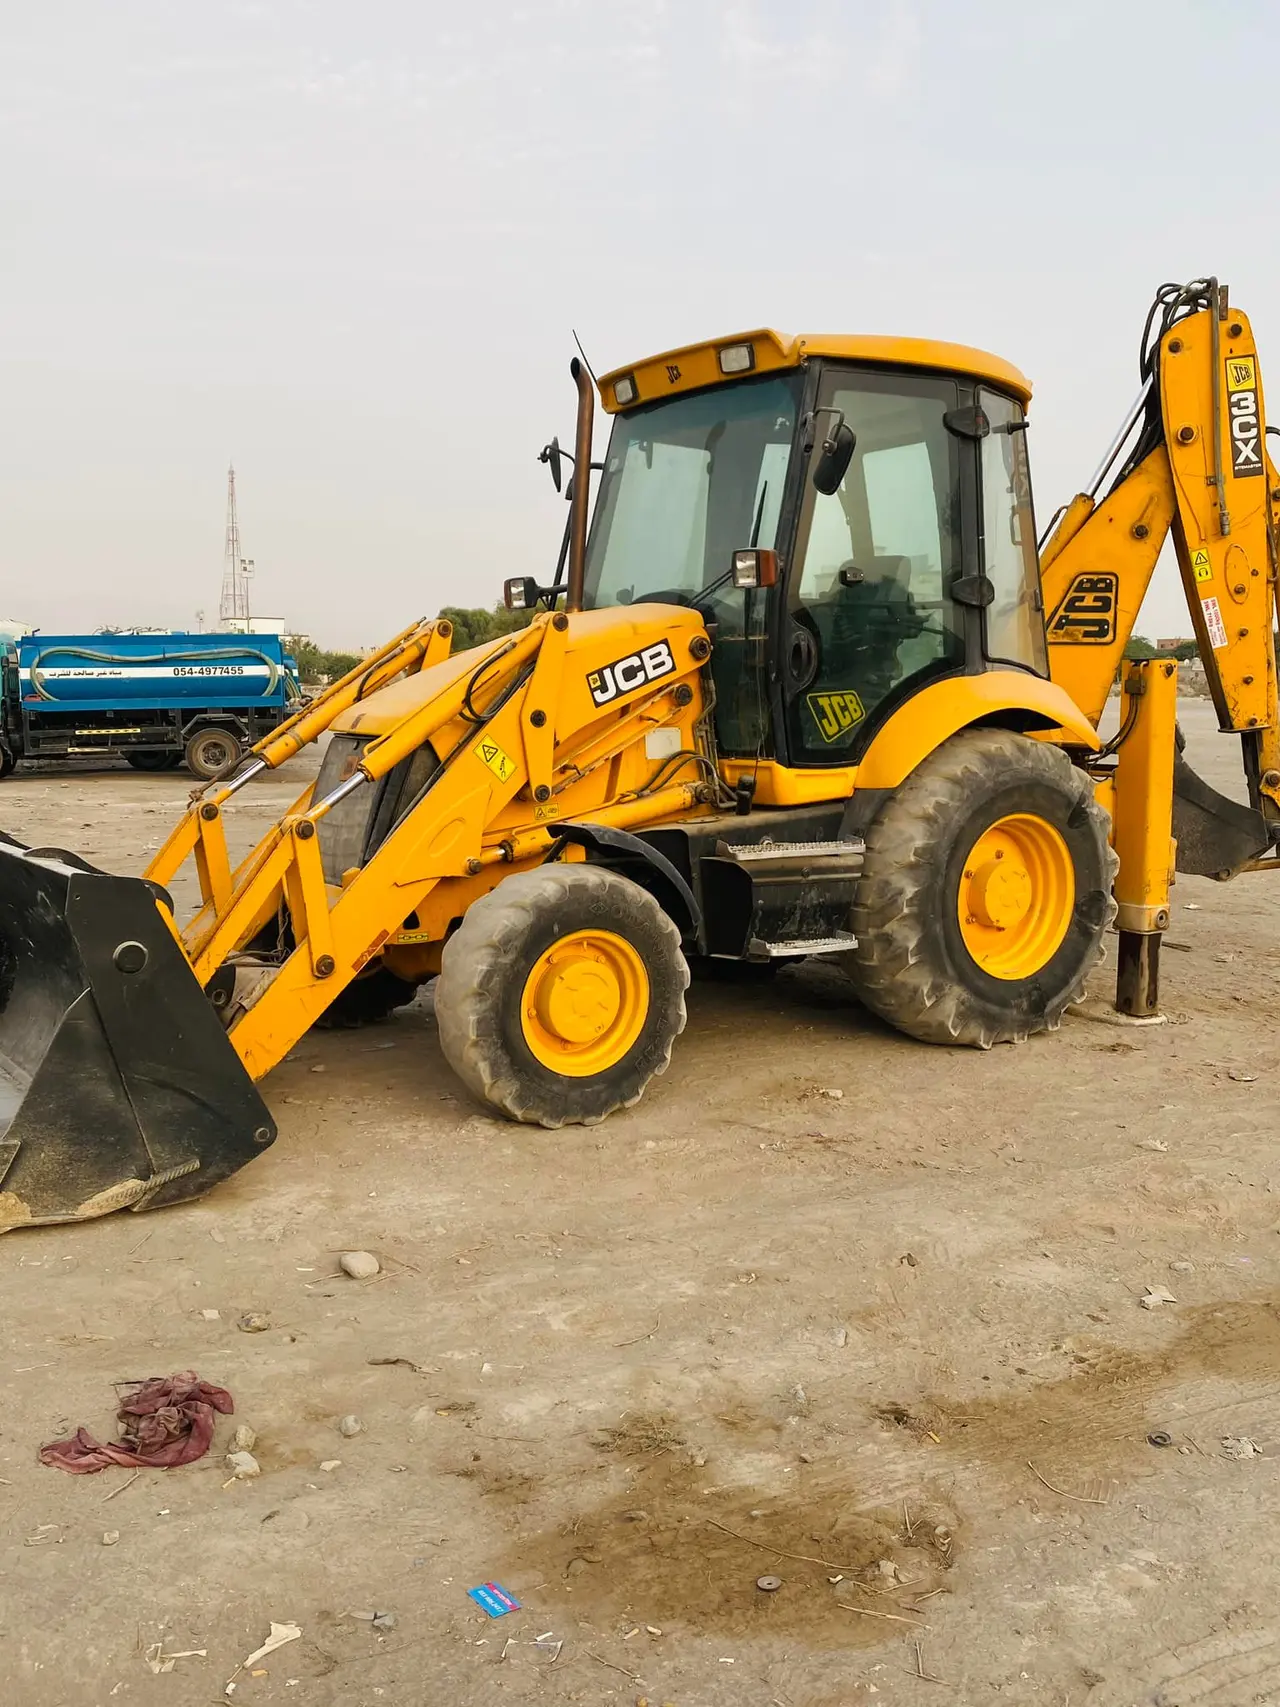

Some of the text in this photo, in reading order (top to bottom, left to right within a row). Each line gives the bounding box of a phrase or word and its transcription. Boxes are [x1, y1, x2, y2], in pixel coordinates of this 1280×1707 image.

[664, 365, 682, 384] JCB
[1233, 364, 1252, 384] JCB
[1230, 391, 1260, 464] 3CX
[1053, 577, 1113, 638] JCB
[173, 666, 244, 676] 054-4977455
[592, 643, 674, 703] JCB
[816, 694, 862, 736] JCB
